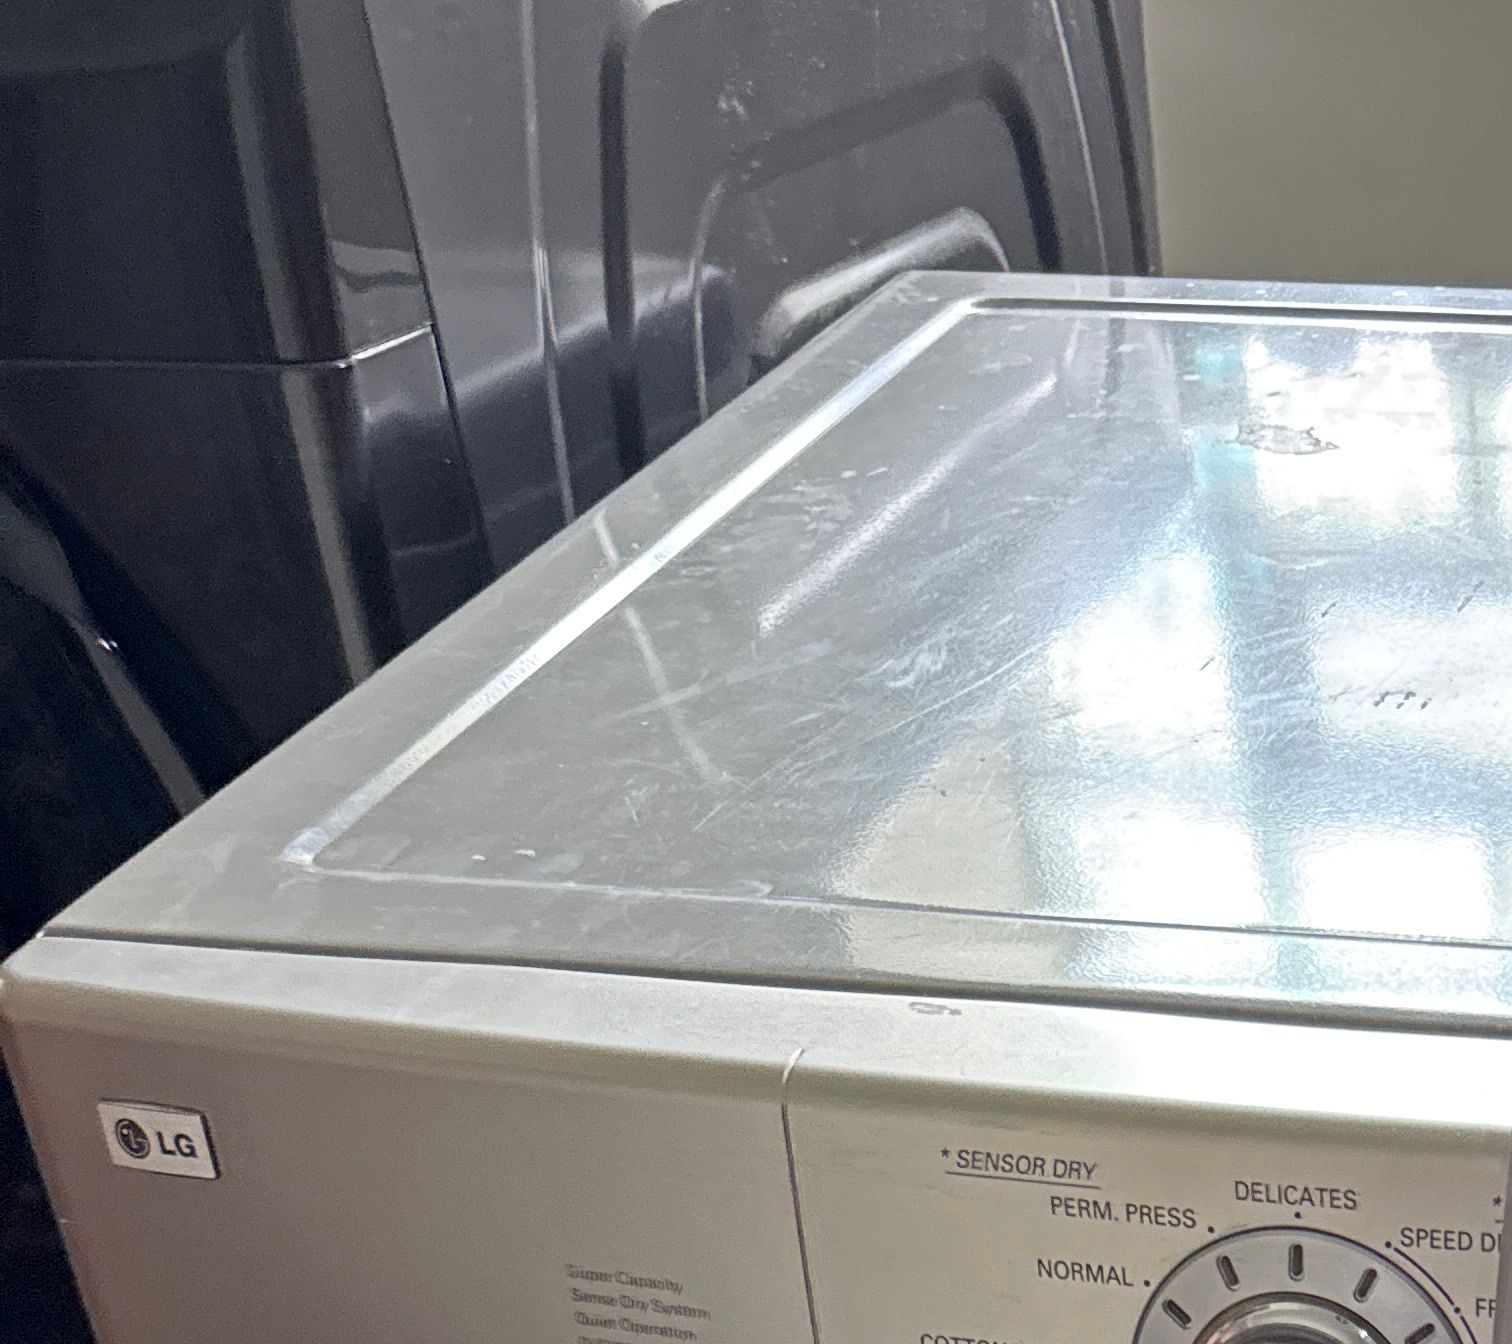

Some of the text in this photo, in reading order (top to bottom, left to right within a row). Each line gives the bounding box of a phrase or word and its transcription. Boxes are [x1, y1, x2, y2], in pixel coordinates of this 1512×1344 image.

[156, 1131, 199, 1158] LG
[956, 1149, 1099, 1182] SENSOR DRY
[1234, 1180, 1357, 1210] DELICATES
[1050, 1195, 1197, 1229] PERM. PRESS
[1400, 1226, 1473, 1251] SPEED
[1037, 1258, 1134, 1287] NORMAL
